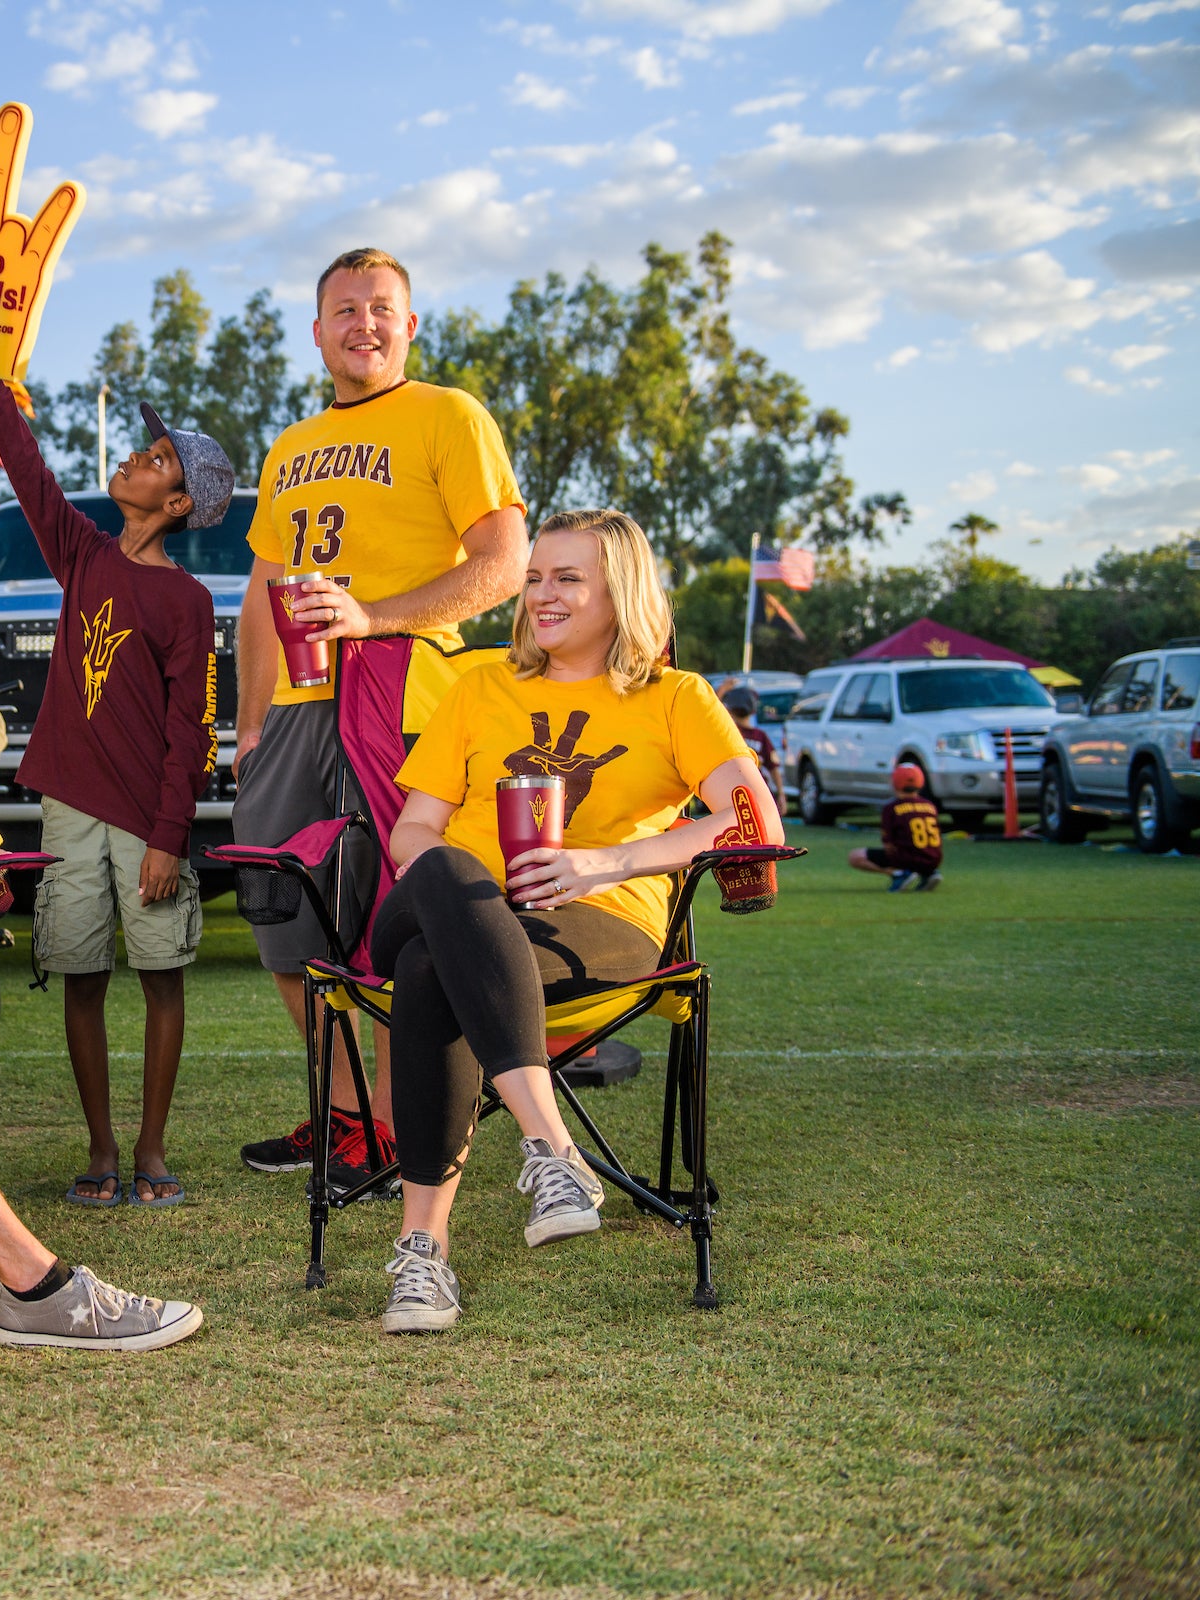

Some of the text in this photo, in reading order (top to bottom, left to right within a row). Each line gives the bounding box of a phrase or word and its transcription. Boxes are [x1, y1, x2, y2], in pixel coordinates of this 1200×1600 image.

[272, 443, 393, 501] ARIZONA
[290, 502, 346, 568] 13
[737, 792, 755, 837] ASU
[909, 815, 941, 850] 85
